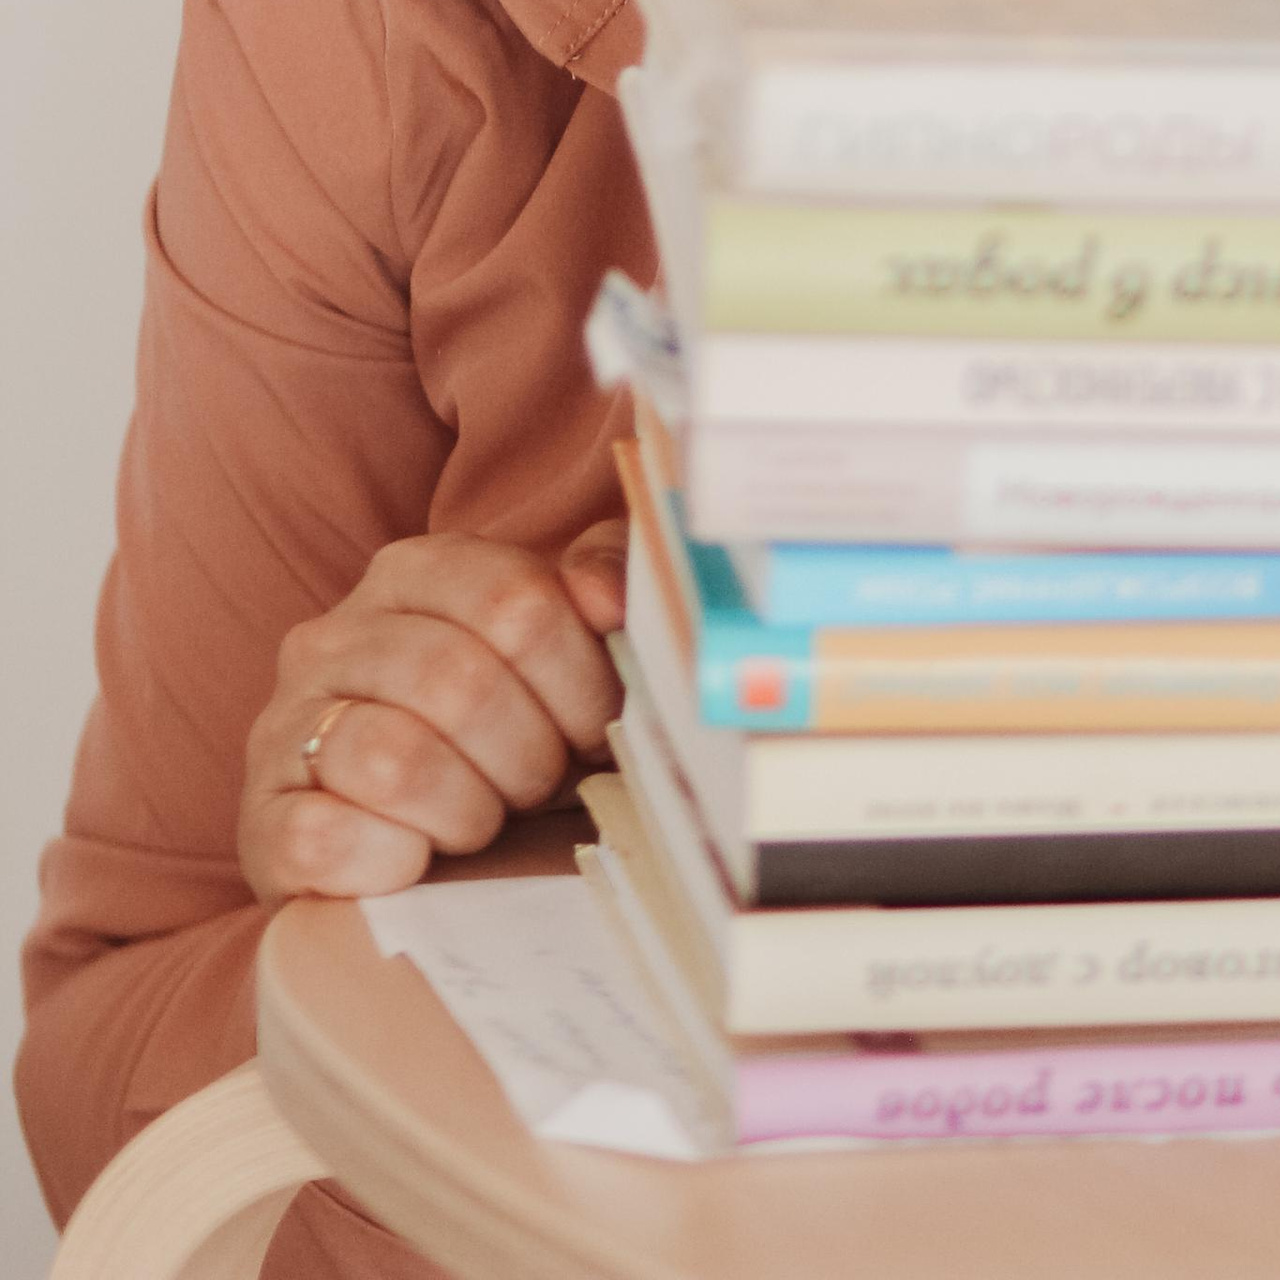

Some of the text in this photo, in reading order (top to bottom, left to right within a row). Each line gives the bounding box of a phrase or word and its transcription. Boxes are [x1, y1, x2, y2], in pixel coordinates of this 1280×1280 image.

[1110, 262, 1154, 325] в
[1073, 955, 1102, 989] с
[876, 1071, 1051, 1134] родов
[1074, 1077, 1246, 1120] после
